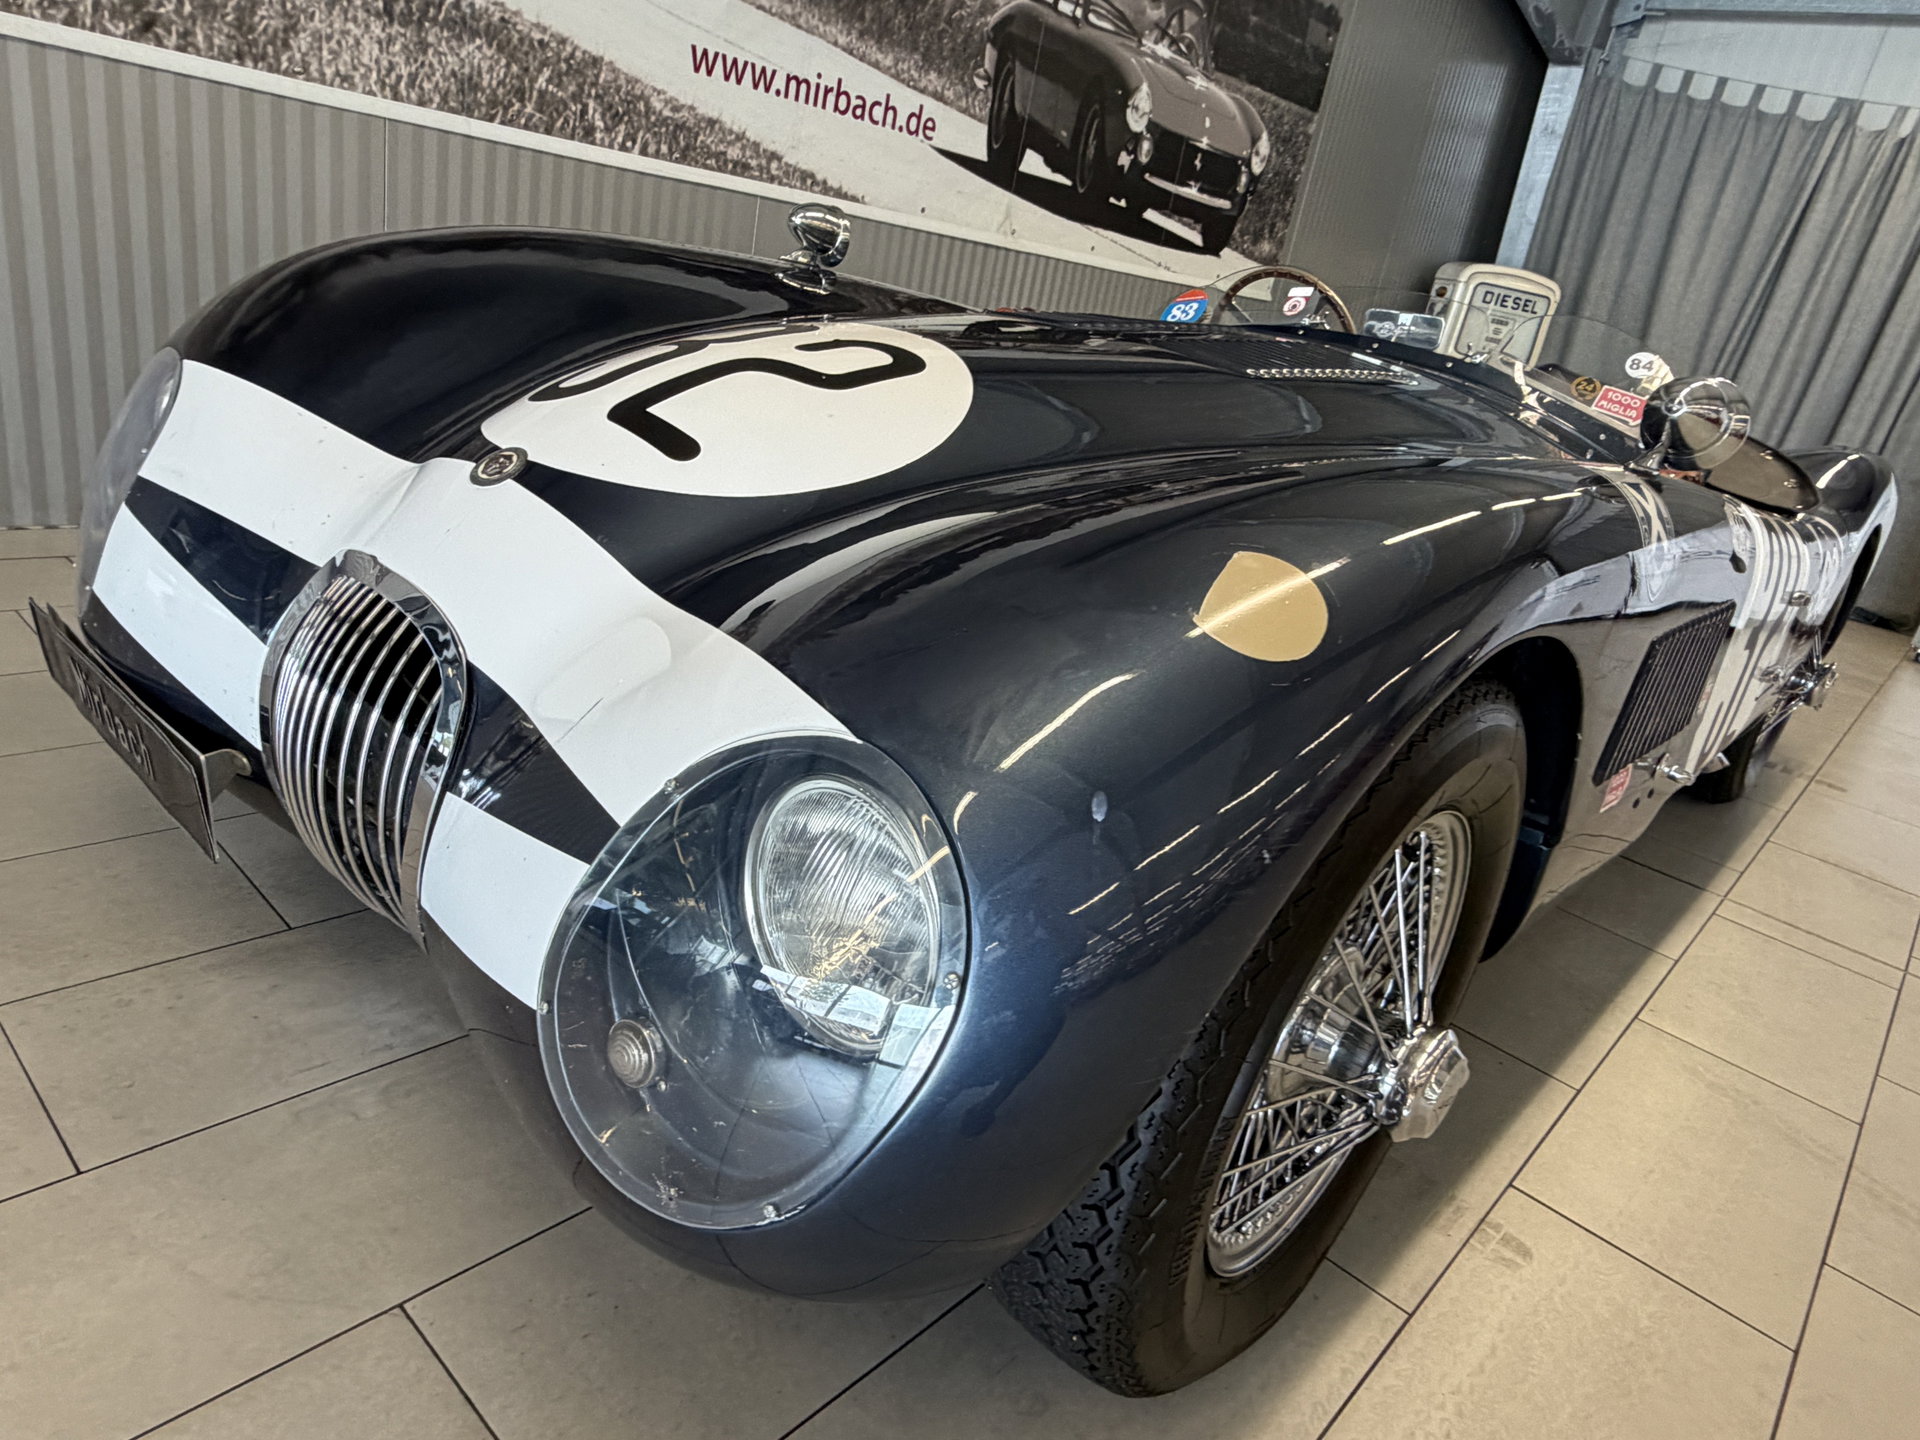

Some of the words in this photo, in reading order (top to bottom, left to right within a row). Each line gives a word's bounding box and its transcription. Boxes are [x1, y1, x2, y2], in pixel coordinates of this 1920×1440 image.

[691, 43, 937, 141] www.mirbach.de
[1166, 302, 1200, 322] 83
[1482, 290, 1538, 315] DIESEL
[1629, 358, 1654, 373] 84
[1597, 400, 1637, 418] MIGLIA
[1607, 391, 1641, 408] 1000
[69, 655, 156, 781] Mirbach
